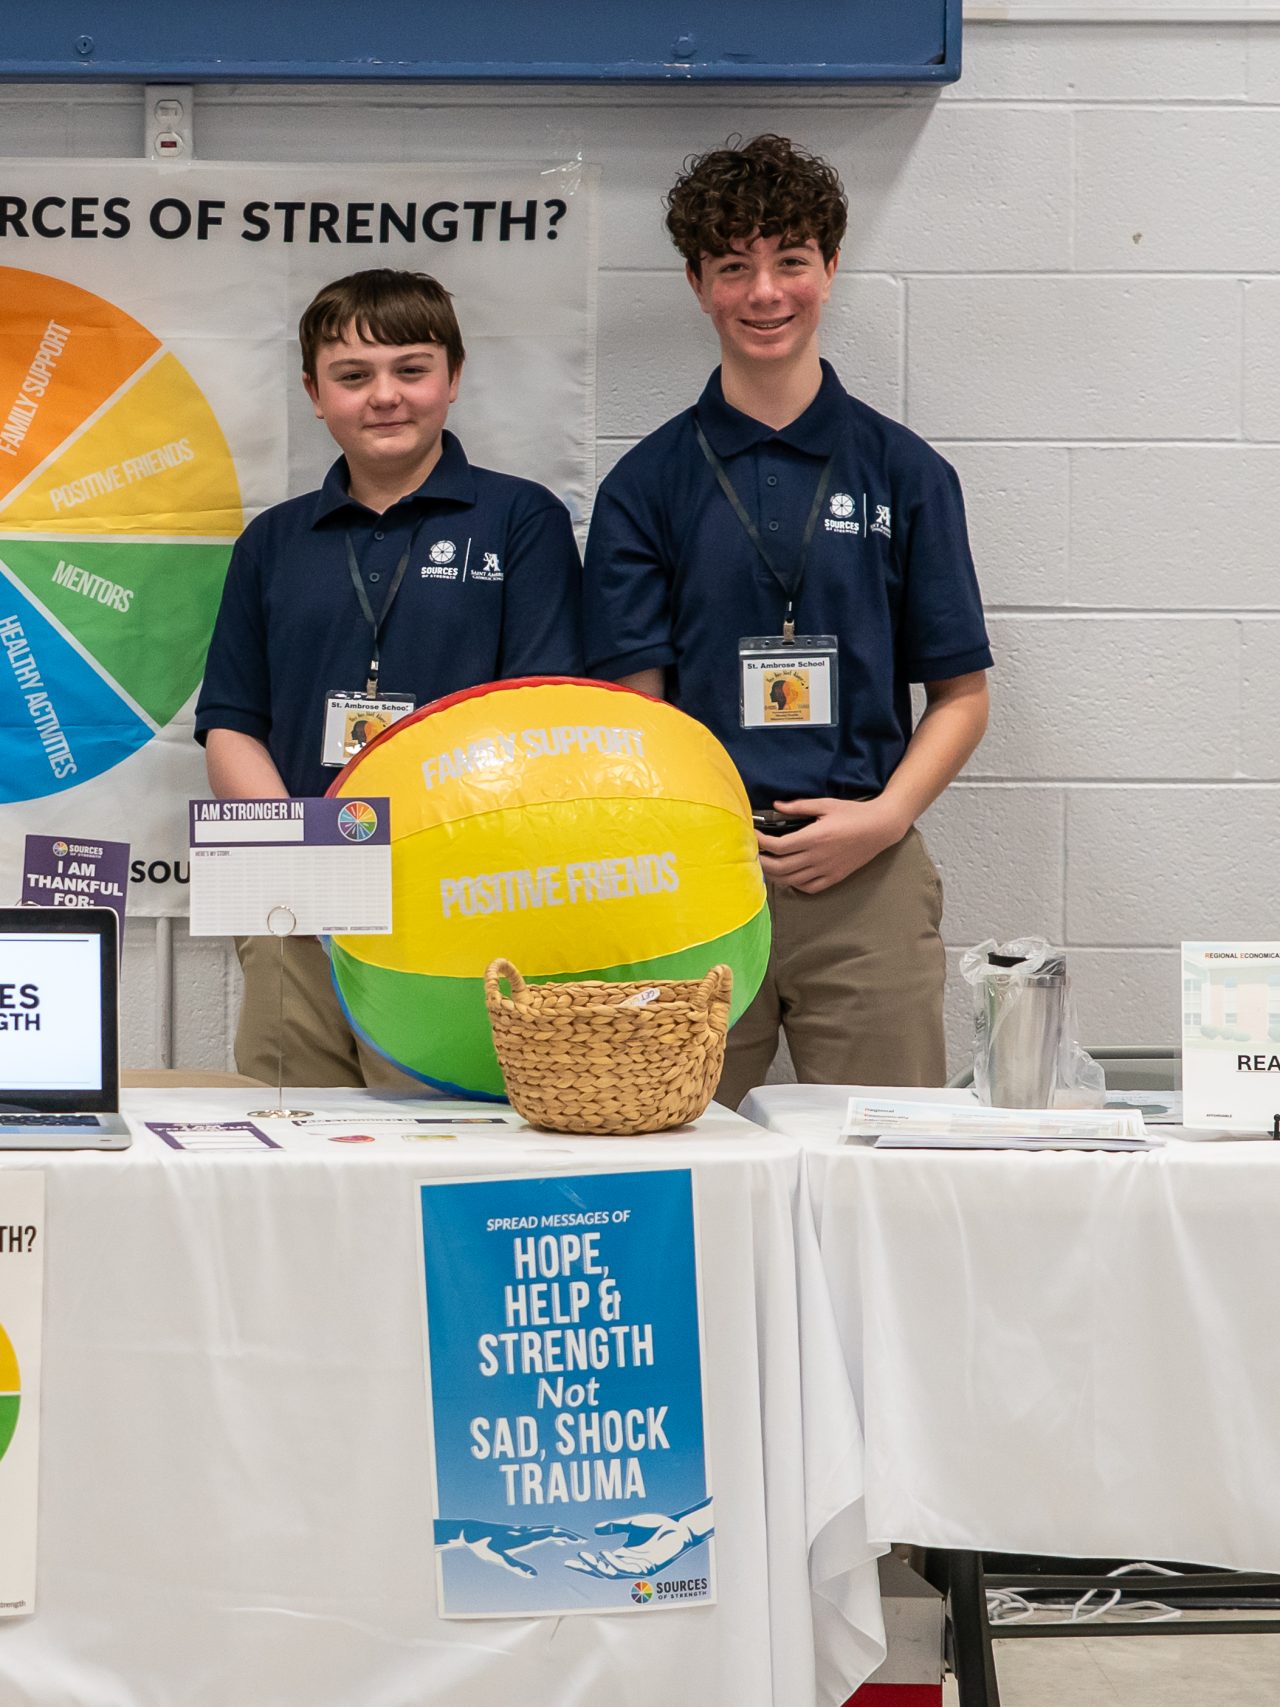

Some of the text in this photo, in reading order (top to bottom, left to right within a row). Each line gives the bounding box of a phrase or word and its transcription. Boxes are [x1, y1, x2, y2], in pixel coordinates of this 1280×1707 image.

[149, 197, 226, 241] OF
[241, 199, 568, 244] STRENGTH?
[21, 319, 71, 398] SUPPORT
[49, 437, 194, 512] POSITIVE FRIENDS
[824, 519, 860, 532] SOURCES
[51, 560, 134, 613] MENTORS
[421, 566, 459, 576] SOURCES
[798, 660, 825, 668] School
[345, 702, 380, 710] Ambrose
[24, 691, 78, 779] ACTIVITIES
[421, 725, 645, 792] FAMILY SUPPORT
[194, 802, 304, 821] I AM STRONGER IN
[69, 844, 104, 856] SOURCES
[27, 874, 123, 897] THANKFUL
[57, 861, 96, 877] I AM
[439, 851, 680, 919] POSITIVE FRIENDS
[53, 893, 95, 907] FOR:
[486, 1209, 631, 1232] SPREAD MESSAGES OF
[513, 1232, 609, 1280] HOPE,
[504, 1278, 622, 1327] HELP &
[478, 1324, 654, 1377] STRENGTH
[537, 1376, 600, 1410] Not
[470, 1406, 671, 1462] SAD, SHOCK
[499, 1457, 646, 1506] TRAUMA
[656, 1578, 708, 1595] SOURCES
[670, 1590, 708, 1600] STRENGTH
